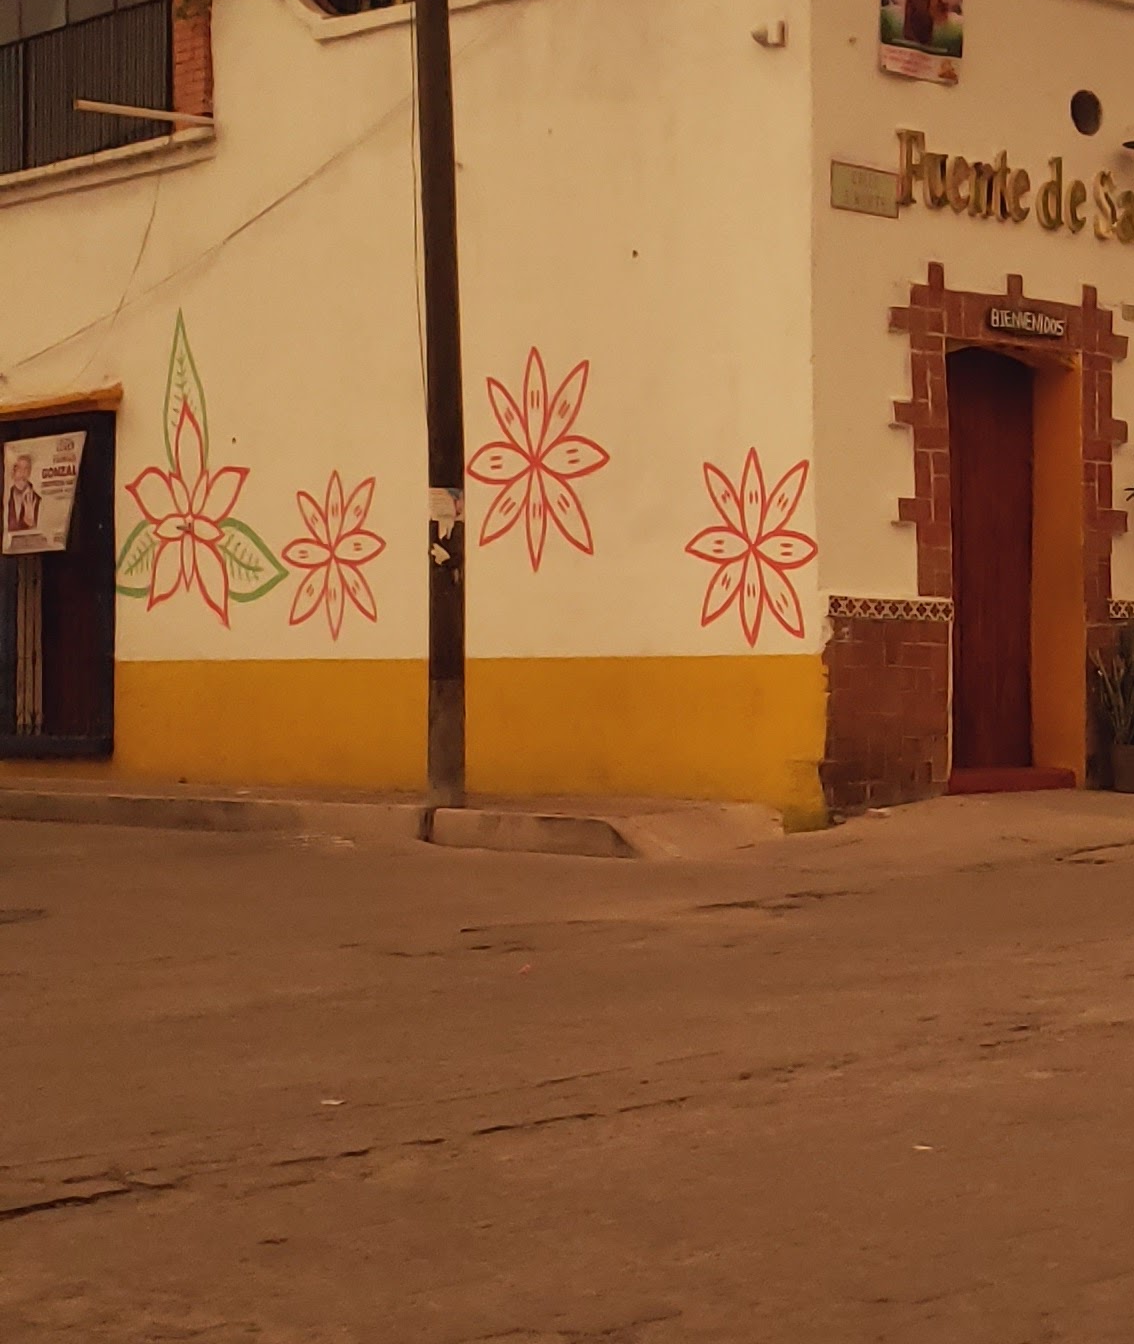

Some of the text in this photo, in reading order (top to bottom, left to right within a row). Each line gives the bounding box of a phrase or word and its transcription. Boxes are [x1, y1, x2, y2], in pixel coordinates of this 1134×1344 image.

[896, 128, 1031, 224] Fuente
[1035, 156, 1088, 235] de
[991, 307, 1066, 337] BIENVENIDOS
